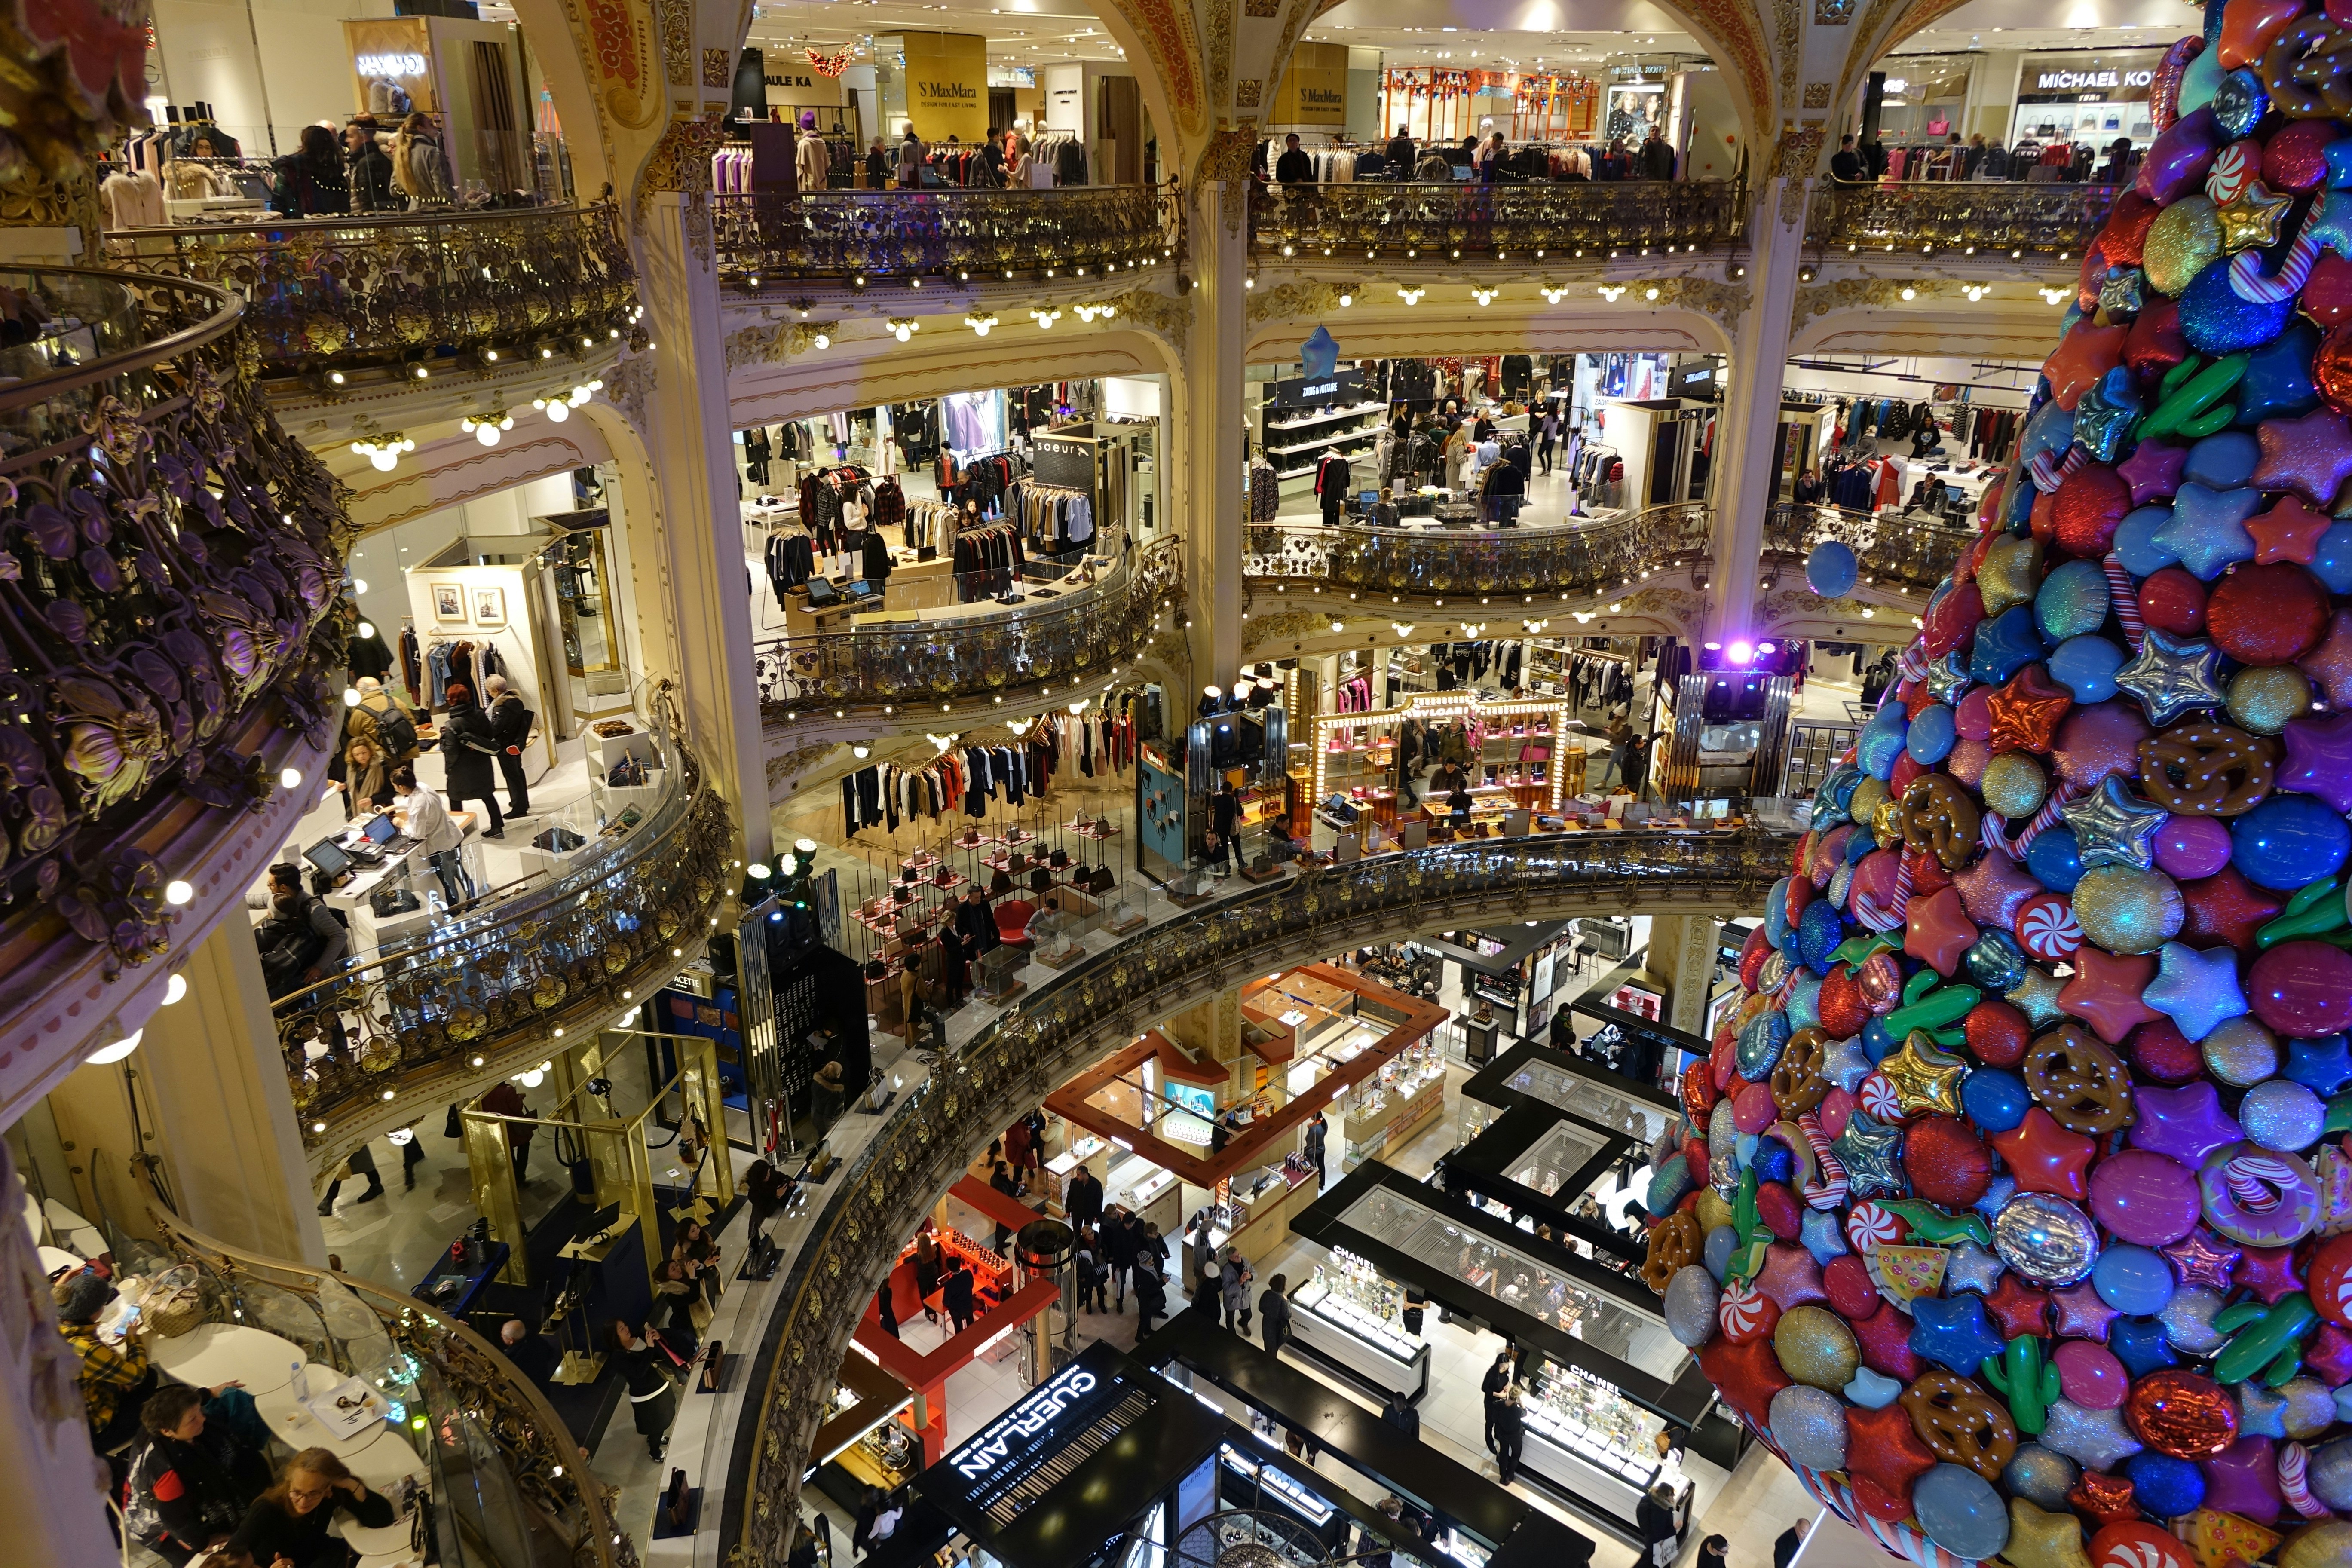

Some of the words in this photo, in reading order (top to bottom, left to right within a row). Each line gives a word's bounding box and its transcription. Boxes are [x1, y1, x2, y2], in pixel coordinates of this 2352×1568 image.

[1611, 66, 1643, 75] MICHAEL
[796, 76, 812, 87] KA
[2038, 72, 2118, 88] MICHAEL
[2124, 71, 2155, 86] KO
[930, 83, 976, 98] MaxMara
[1308, 89, 1341, 103] MaxMara
[1038, 442, 1074, 454] soeur
[1146, 750, 1163, 767] Valextra
[1424, 946, 1443, 958] BROWN
[671, 976, 700, 987] ACETTE
[1334, 1245, 1377, 1272] CHANEL
[1292, 1320, 1311, 1332] CHANEL
[1570, 1364, 1622, 1396] CHANEL
[959, 1372, 1096, 1479] GUERLAIN
[984, 1418, 1010, 1439] PARIS
[1180, 1459, 1214, 1491] GUERLAIN
